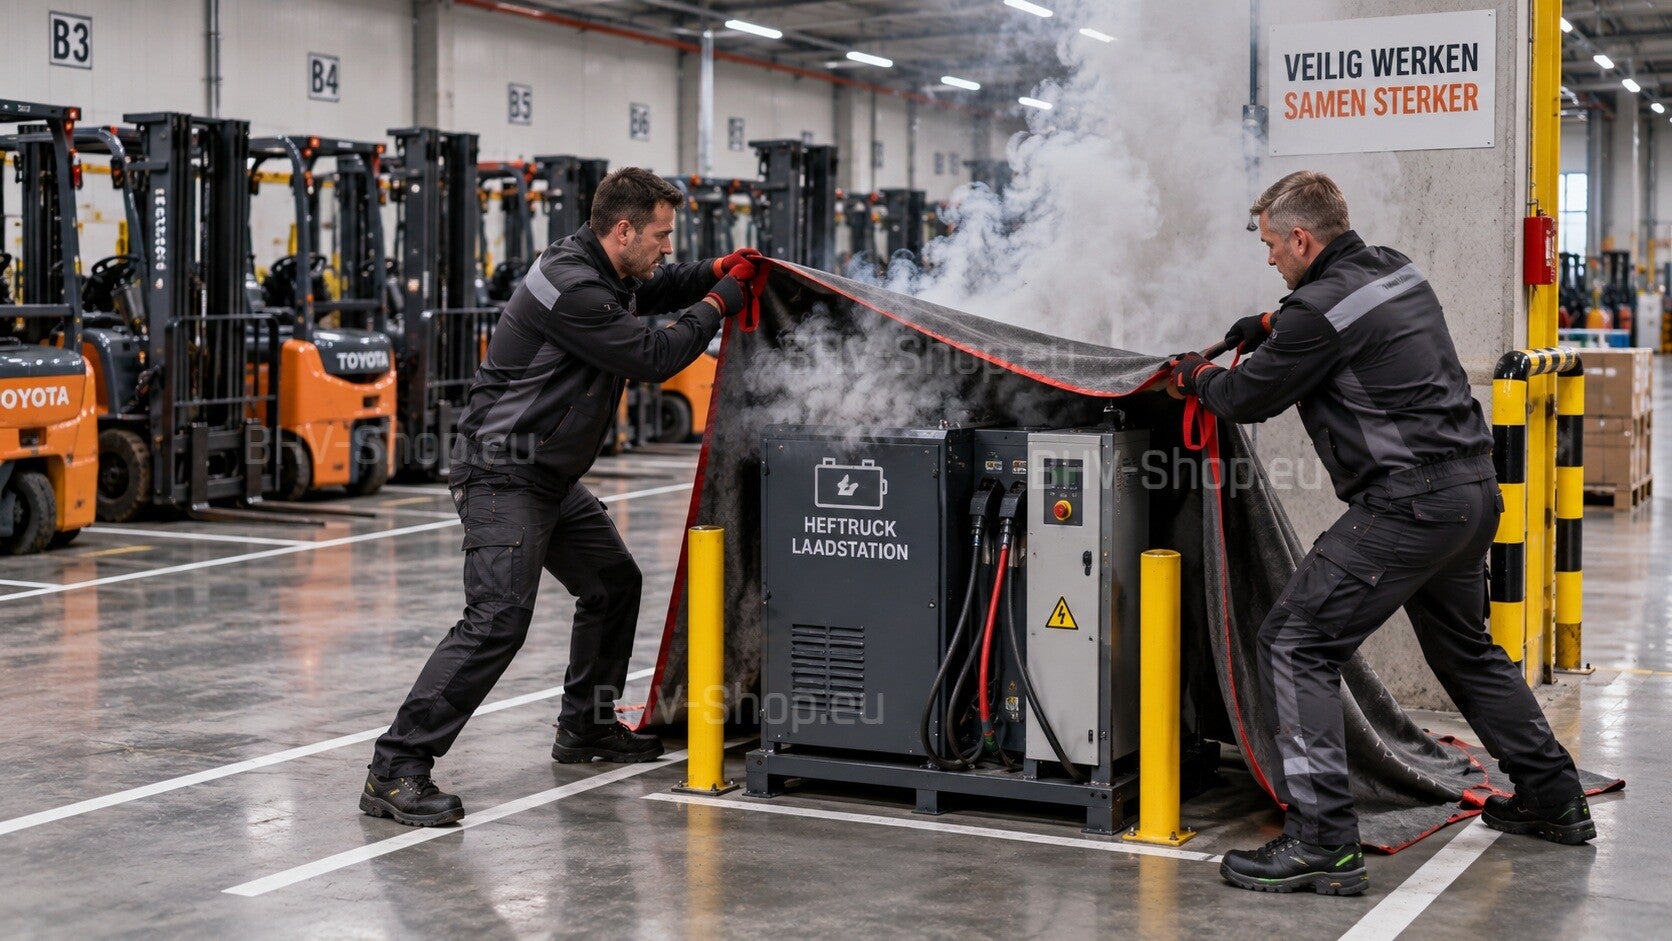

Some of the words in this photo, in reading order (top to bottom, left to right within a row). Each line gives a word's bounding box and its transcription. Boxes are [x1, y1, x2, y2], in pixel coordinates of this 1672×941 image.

[53, 18, 89, 62] B3
[312, 59, 339, 95] B4
[1284, 49, 1363, 82] VEILIG
[1371, 42, 1479, 77] WERKEN
[510, 89, 531, 119] B5
[1284, 88, 1366, 120] SAMEN
[1373, 82, 1479, 116] STERKER
[336, 350, 389, 370] TOYOTA
[0, 385, 70, 409] OYOTA
[804, 515, 898, 539] HEFTRUCK
[792, 538, 909, 561] LAADSTATION
